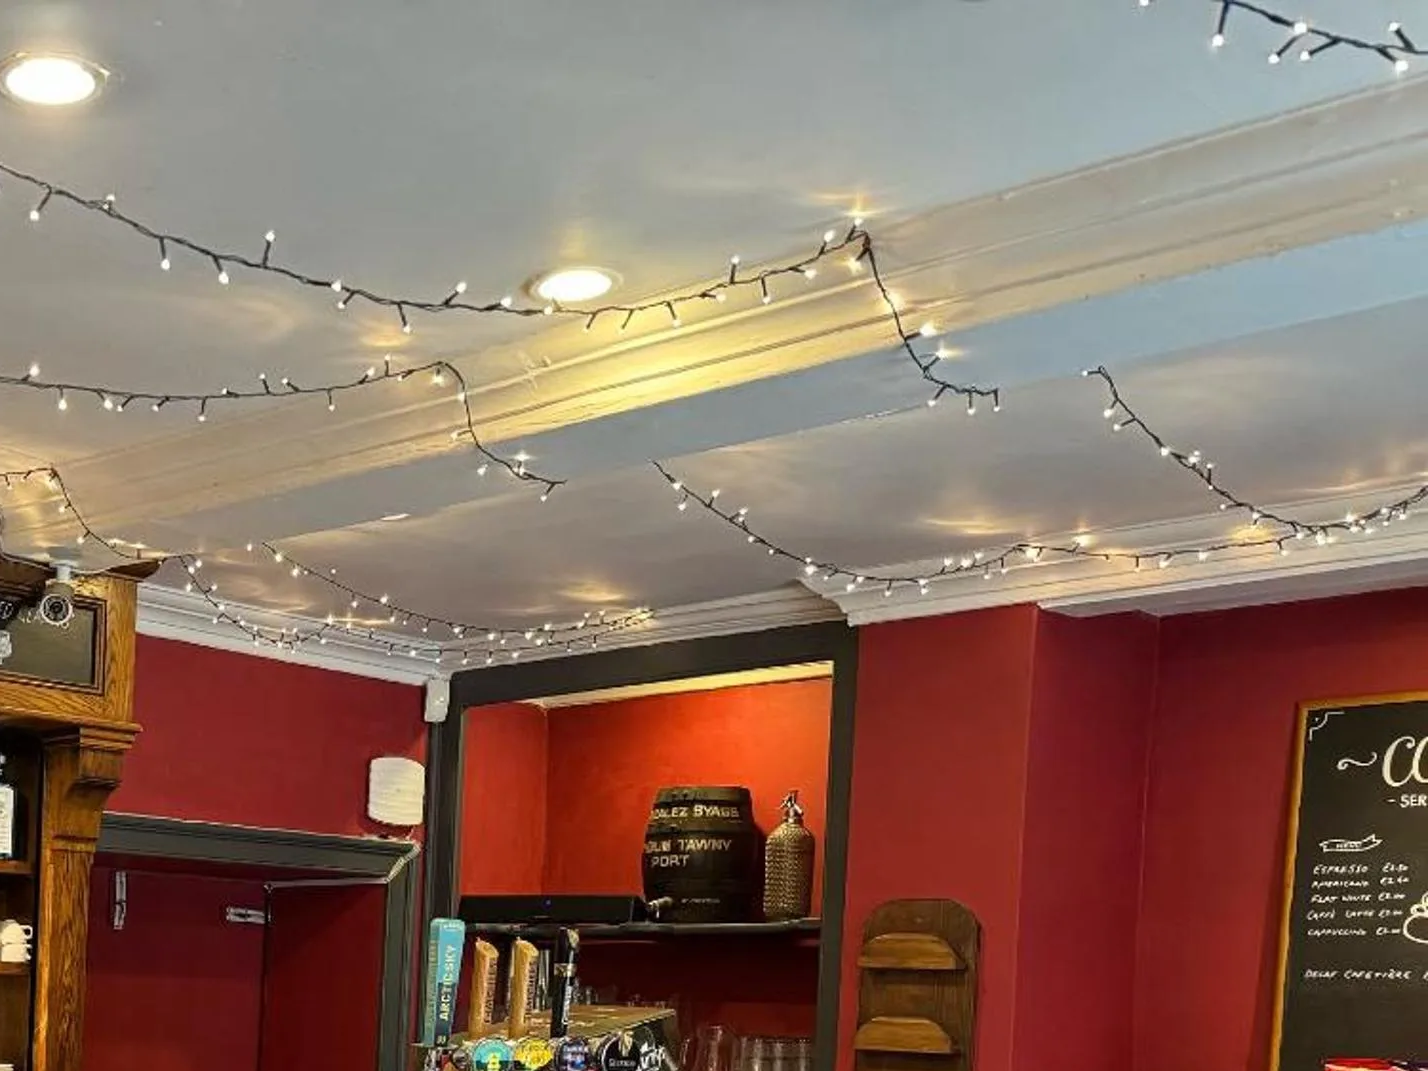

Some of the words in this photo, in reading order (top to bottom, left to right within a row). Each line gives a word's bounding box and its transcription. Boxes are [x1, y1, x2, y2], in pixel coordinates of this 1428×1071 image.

[678, 838, 732, 853] TAWNY
[651, 853, 690, 869] PORT
[1313, 863, 1369, 875] ESPRESSO
[1307, 928, 1367, 938] CAPPUCCINO
[443, 944, 458, 973] SKY
[1304, 968, 1337, 980] DECAF
[439, 973, 454, 1021] ARCTIC
